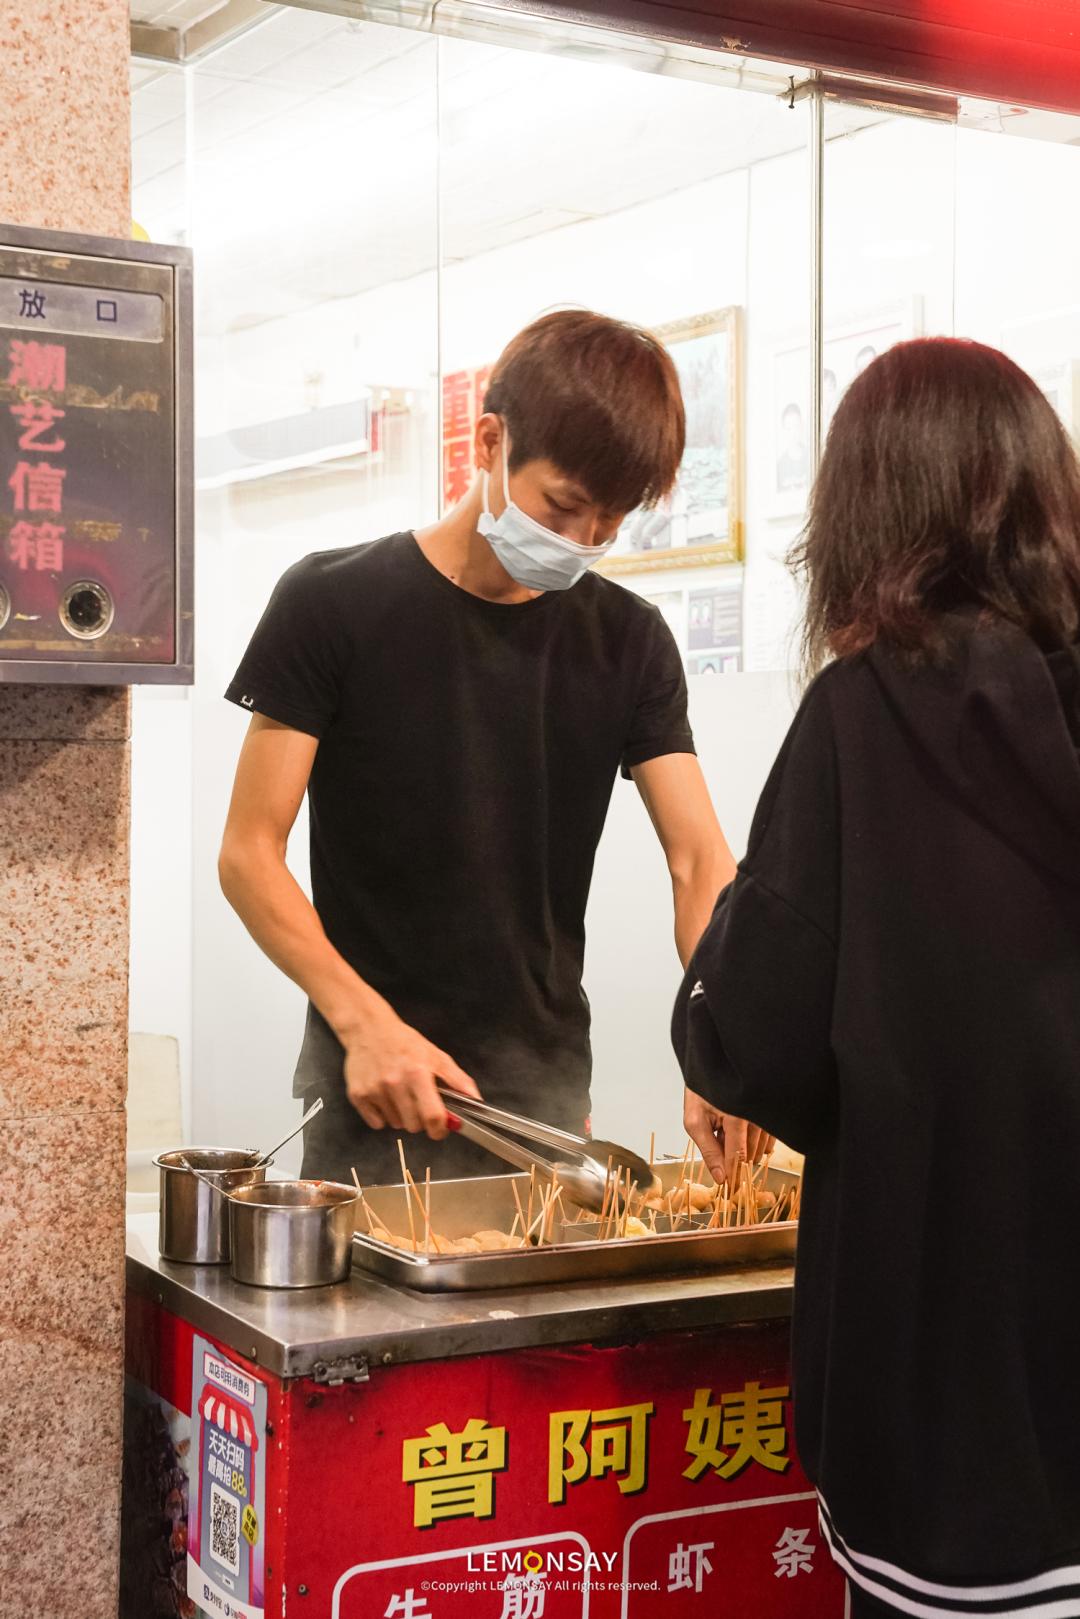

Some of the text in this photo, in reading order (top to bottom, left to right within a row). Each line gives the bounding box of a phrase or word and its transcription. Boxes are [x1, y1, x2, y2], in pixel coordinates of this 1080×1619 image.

[8, 340, 66, 571] 潮艺信箱
[208, 1428, 245, 1472] 天天扫码
[402, 1381, 790, 1528] 曾阿姨
[667, 1527, 816, 1593] 虾条
